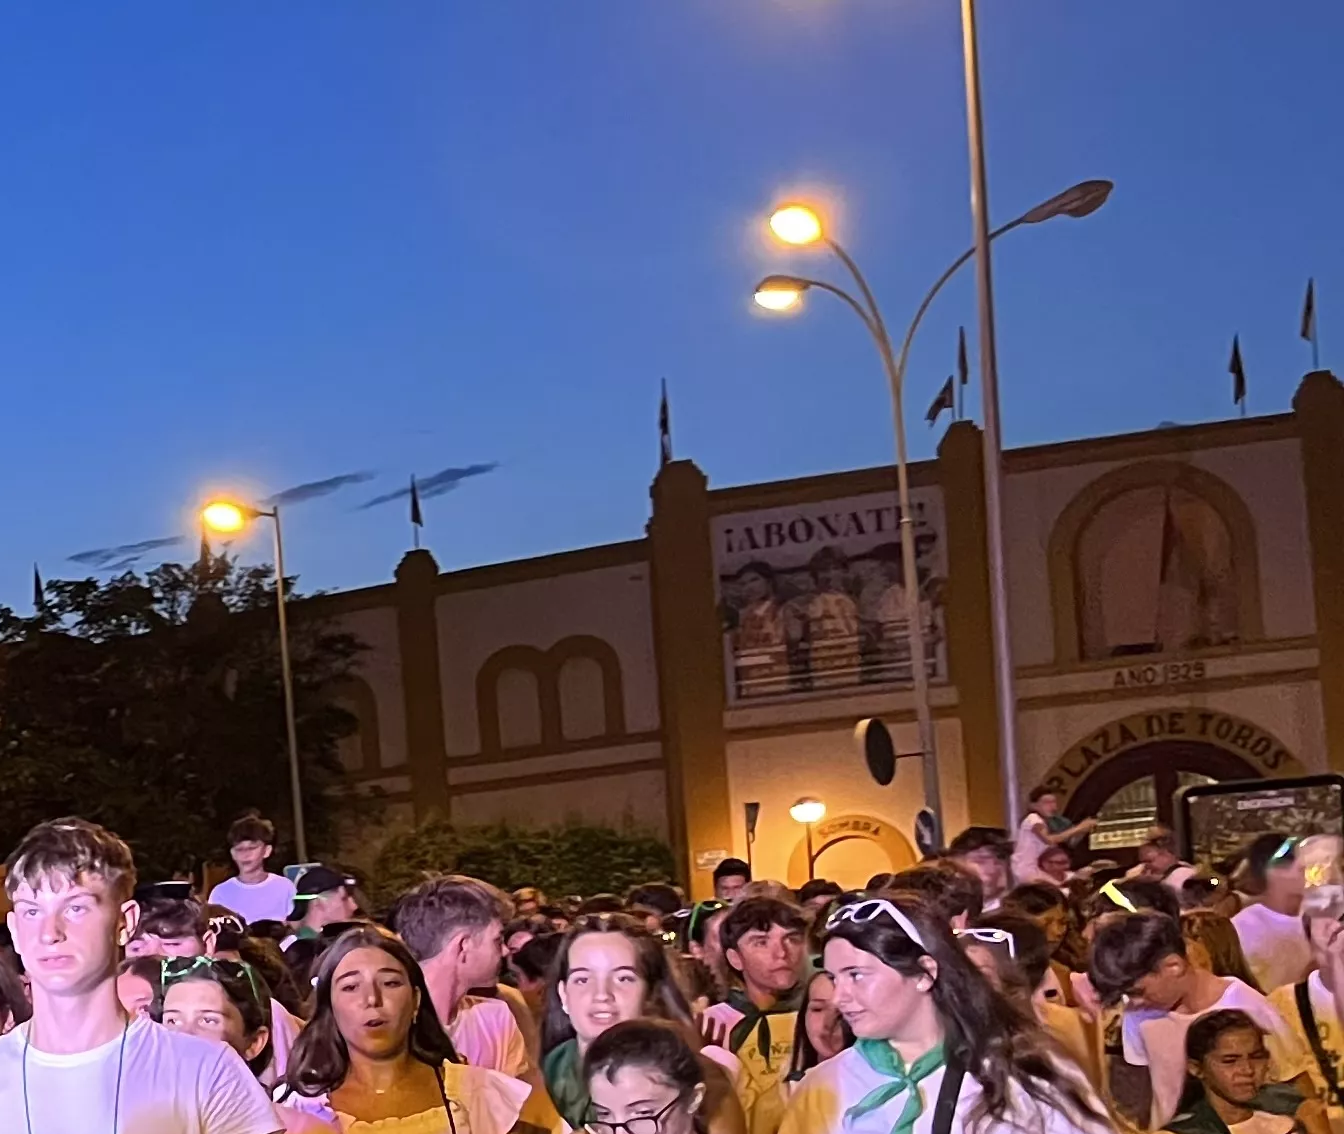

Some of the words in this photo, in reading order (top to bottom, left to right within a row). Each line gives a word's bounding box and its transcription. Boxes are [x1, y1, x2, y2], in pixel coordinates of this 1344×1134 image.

[1046, 722, 1138, 797] PLAZA
[1146, 712, 1186, 737] DE
[1198, 713, 1286, 771] TOROS
[818, 820, 882, 840] SOMBRA
